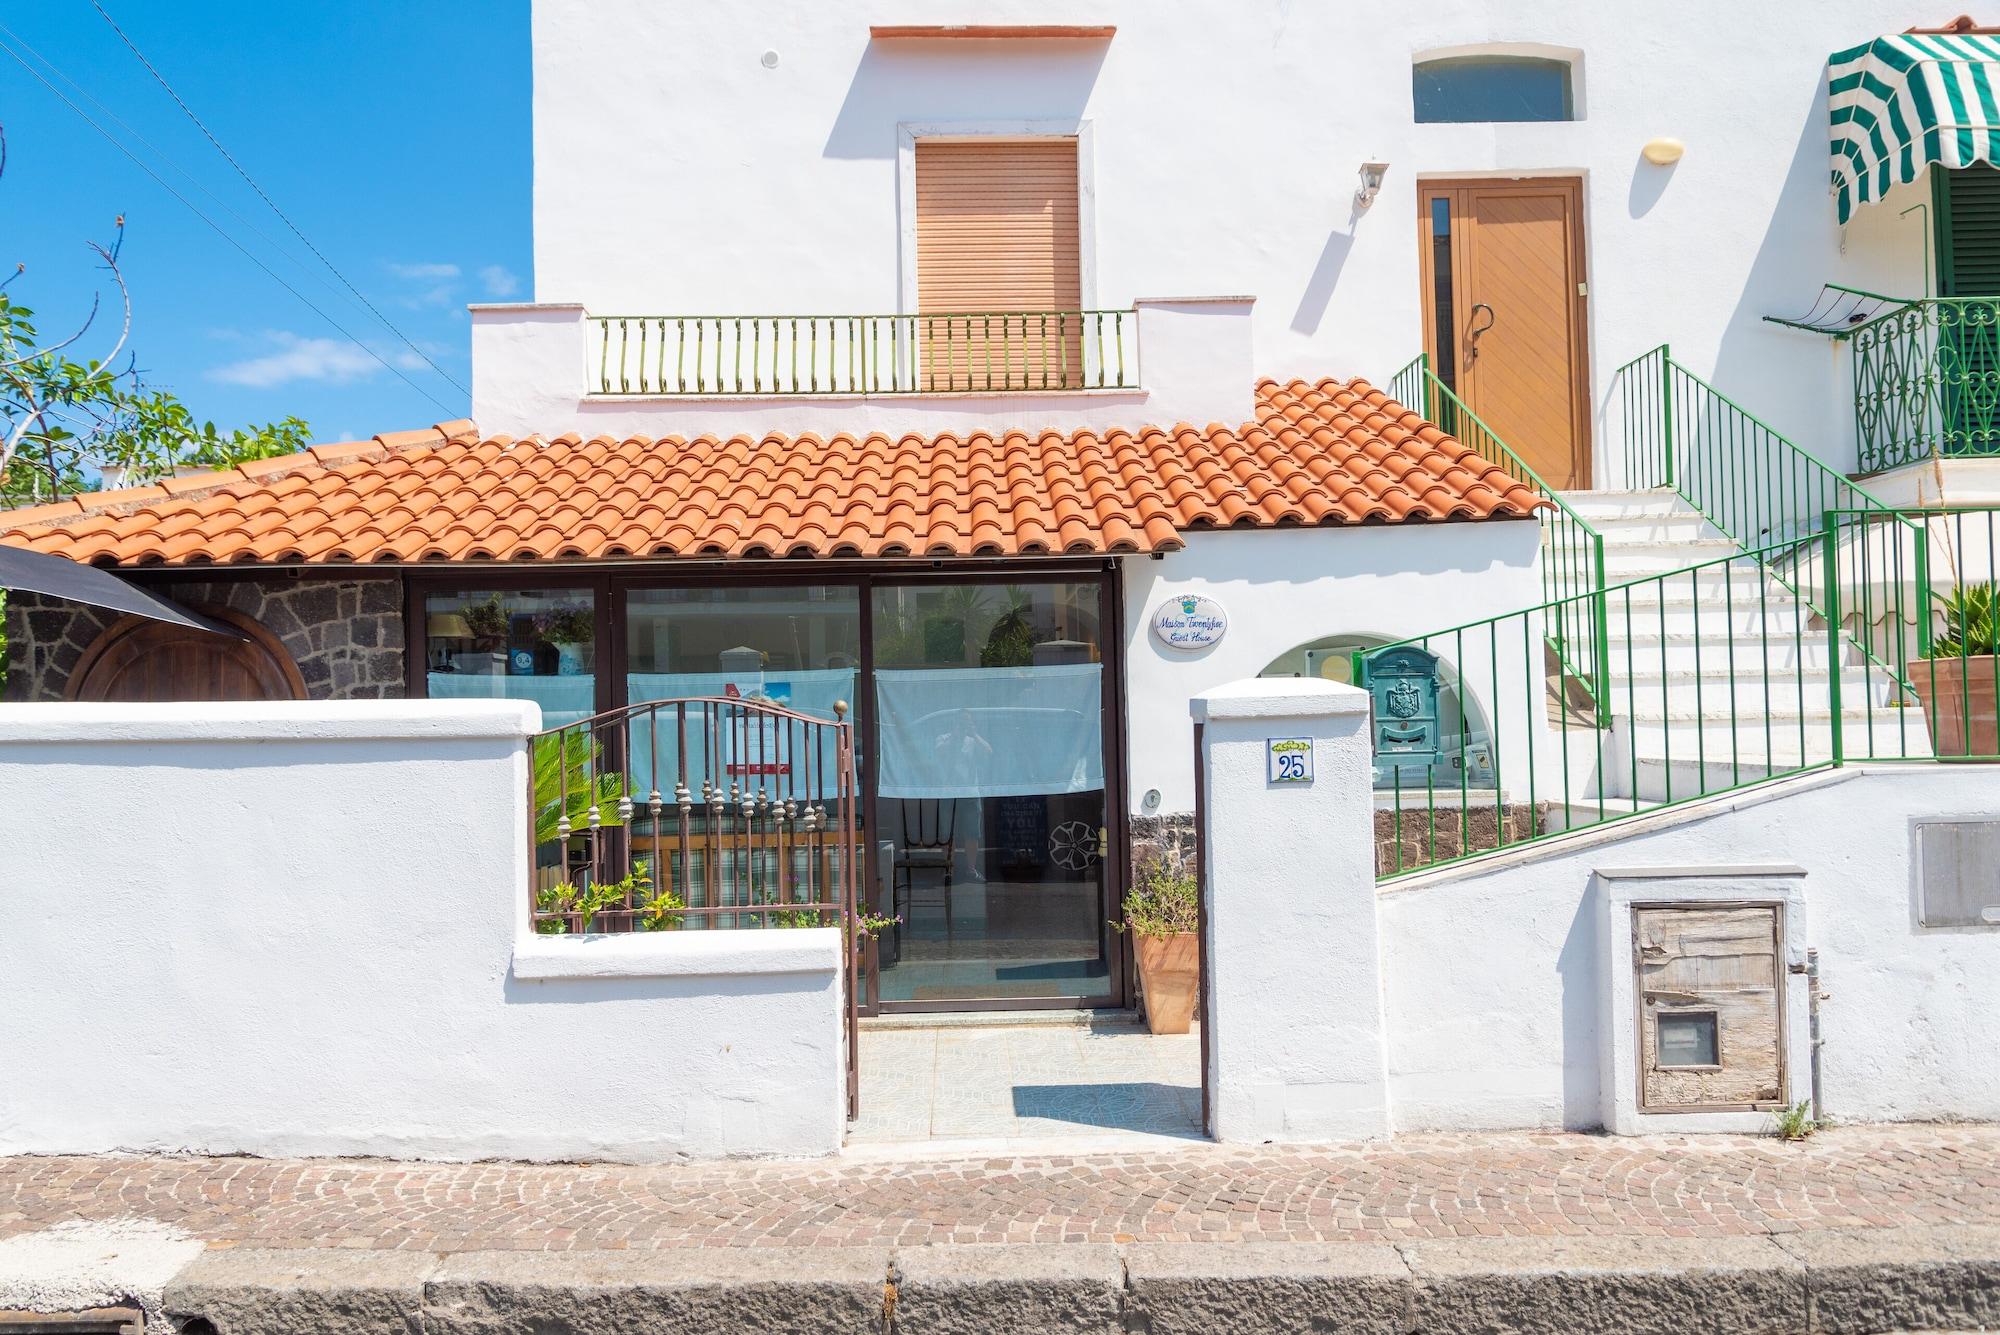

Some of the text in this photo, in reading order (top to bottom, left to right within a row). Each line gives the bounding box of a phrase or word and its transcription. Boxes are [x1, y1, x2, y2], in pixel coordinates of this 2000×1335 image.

[1156, 616, 1185, 629] Maison
[1169, 632, 1212, 645] Guest House
[1279, 755, 1305, 779] 25
[1008, 817, 1036, 828] YOU
